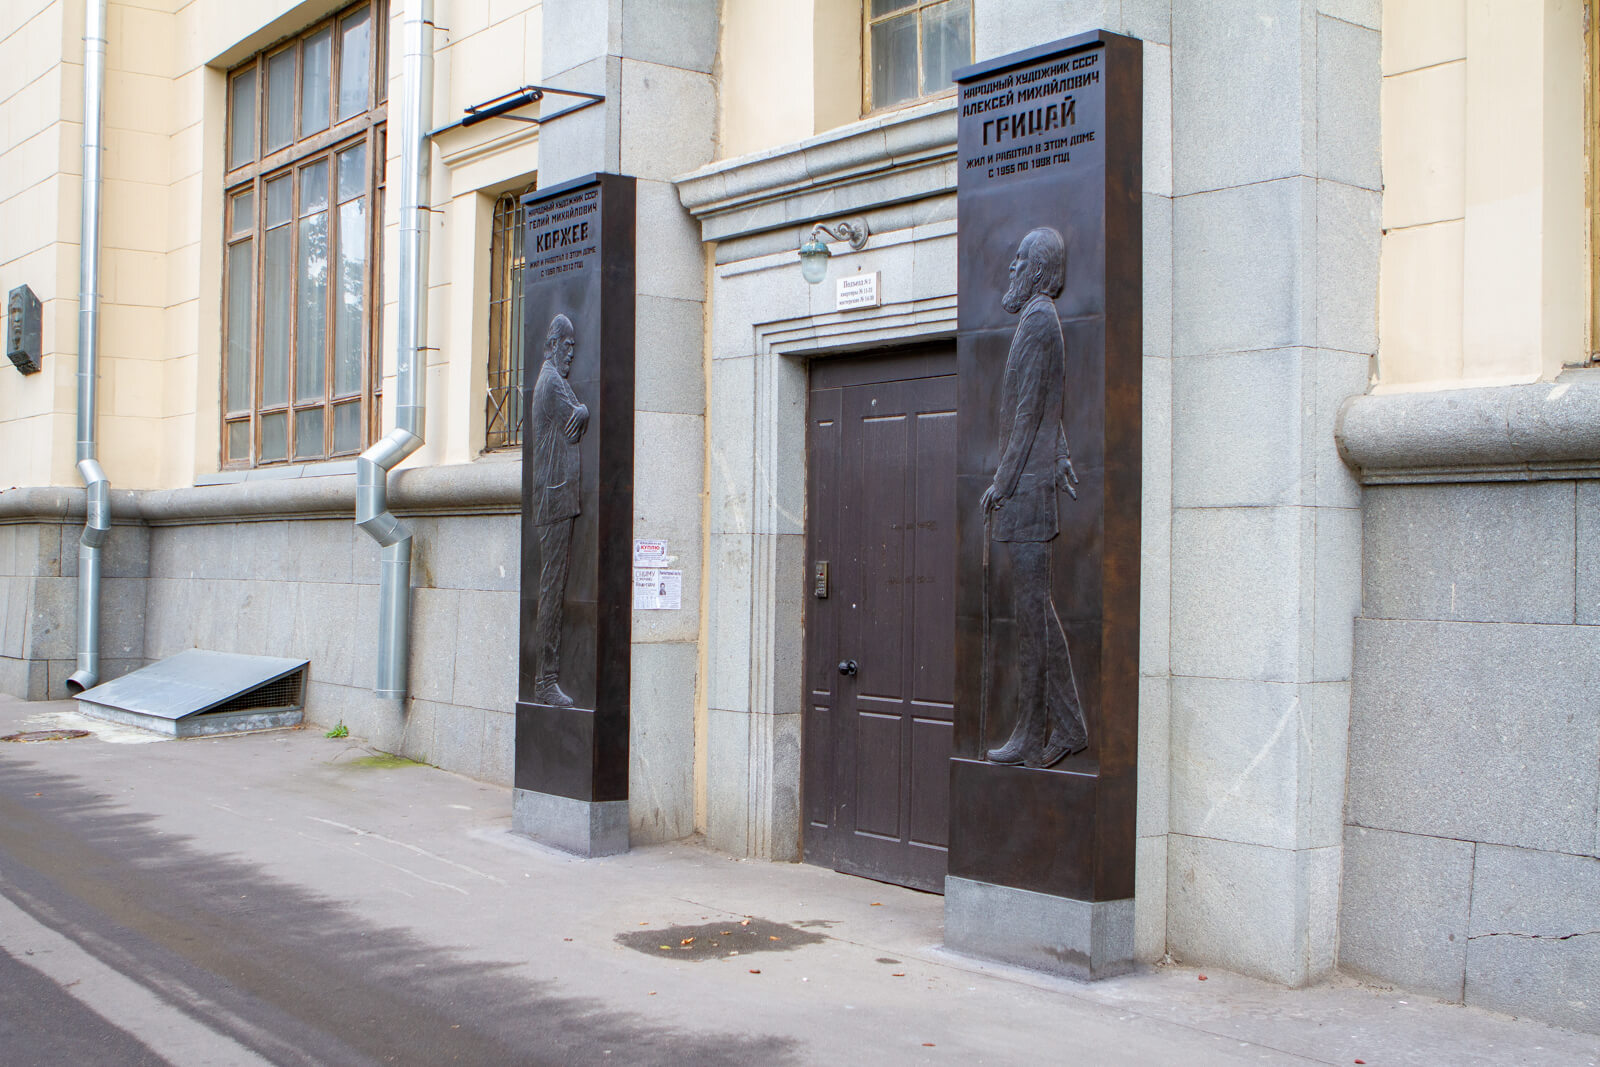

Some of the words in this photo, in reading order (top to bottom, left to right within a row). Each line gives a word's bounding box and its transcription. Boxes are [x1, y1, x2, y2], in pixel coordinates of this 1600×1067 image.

[964, 75, 1013, 99] НАРОДНЫЙ
[1016, 61, 1070, 86] ХУДОЖНИК
[1072, 54, 1098, 71] СССР
[963, 90, 1014, 117] АЛЕКСЕЙ
[1018, 71, 1099, 103] МИХАЙЛОВИЧ
[983, 95, 1076, 146] ГРИЦАЙ
[966, 156, 985, 169] ЖИЛ
[988, 154, 993, 163] И
[996, 145, 1033, 162] РАБОТАЛ
[1036, 144, 1041, 153] В
[1044, 138, 1067, 152] ЭТОМ
[1070, 131, 1095, 147] ДОМЕ
[988, 169, 994, 178] С
[996, 165, 1015, 177] 1955
[1017, 161, 1028, 172] ПО
[1032, 156, 1051, 169] 1998
[1053, 152, 1070, 164] ГОД
[585, 190, 598, 201] СССР
[529, 214, 549, 230] ГЕЛИЙ
[552, 202, 597, 224] МИХАЙЛОВИЧ
[536, 222, 588, 253] КОРЖЕВ
[843, 279, 863, 288] Подъезд
